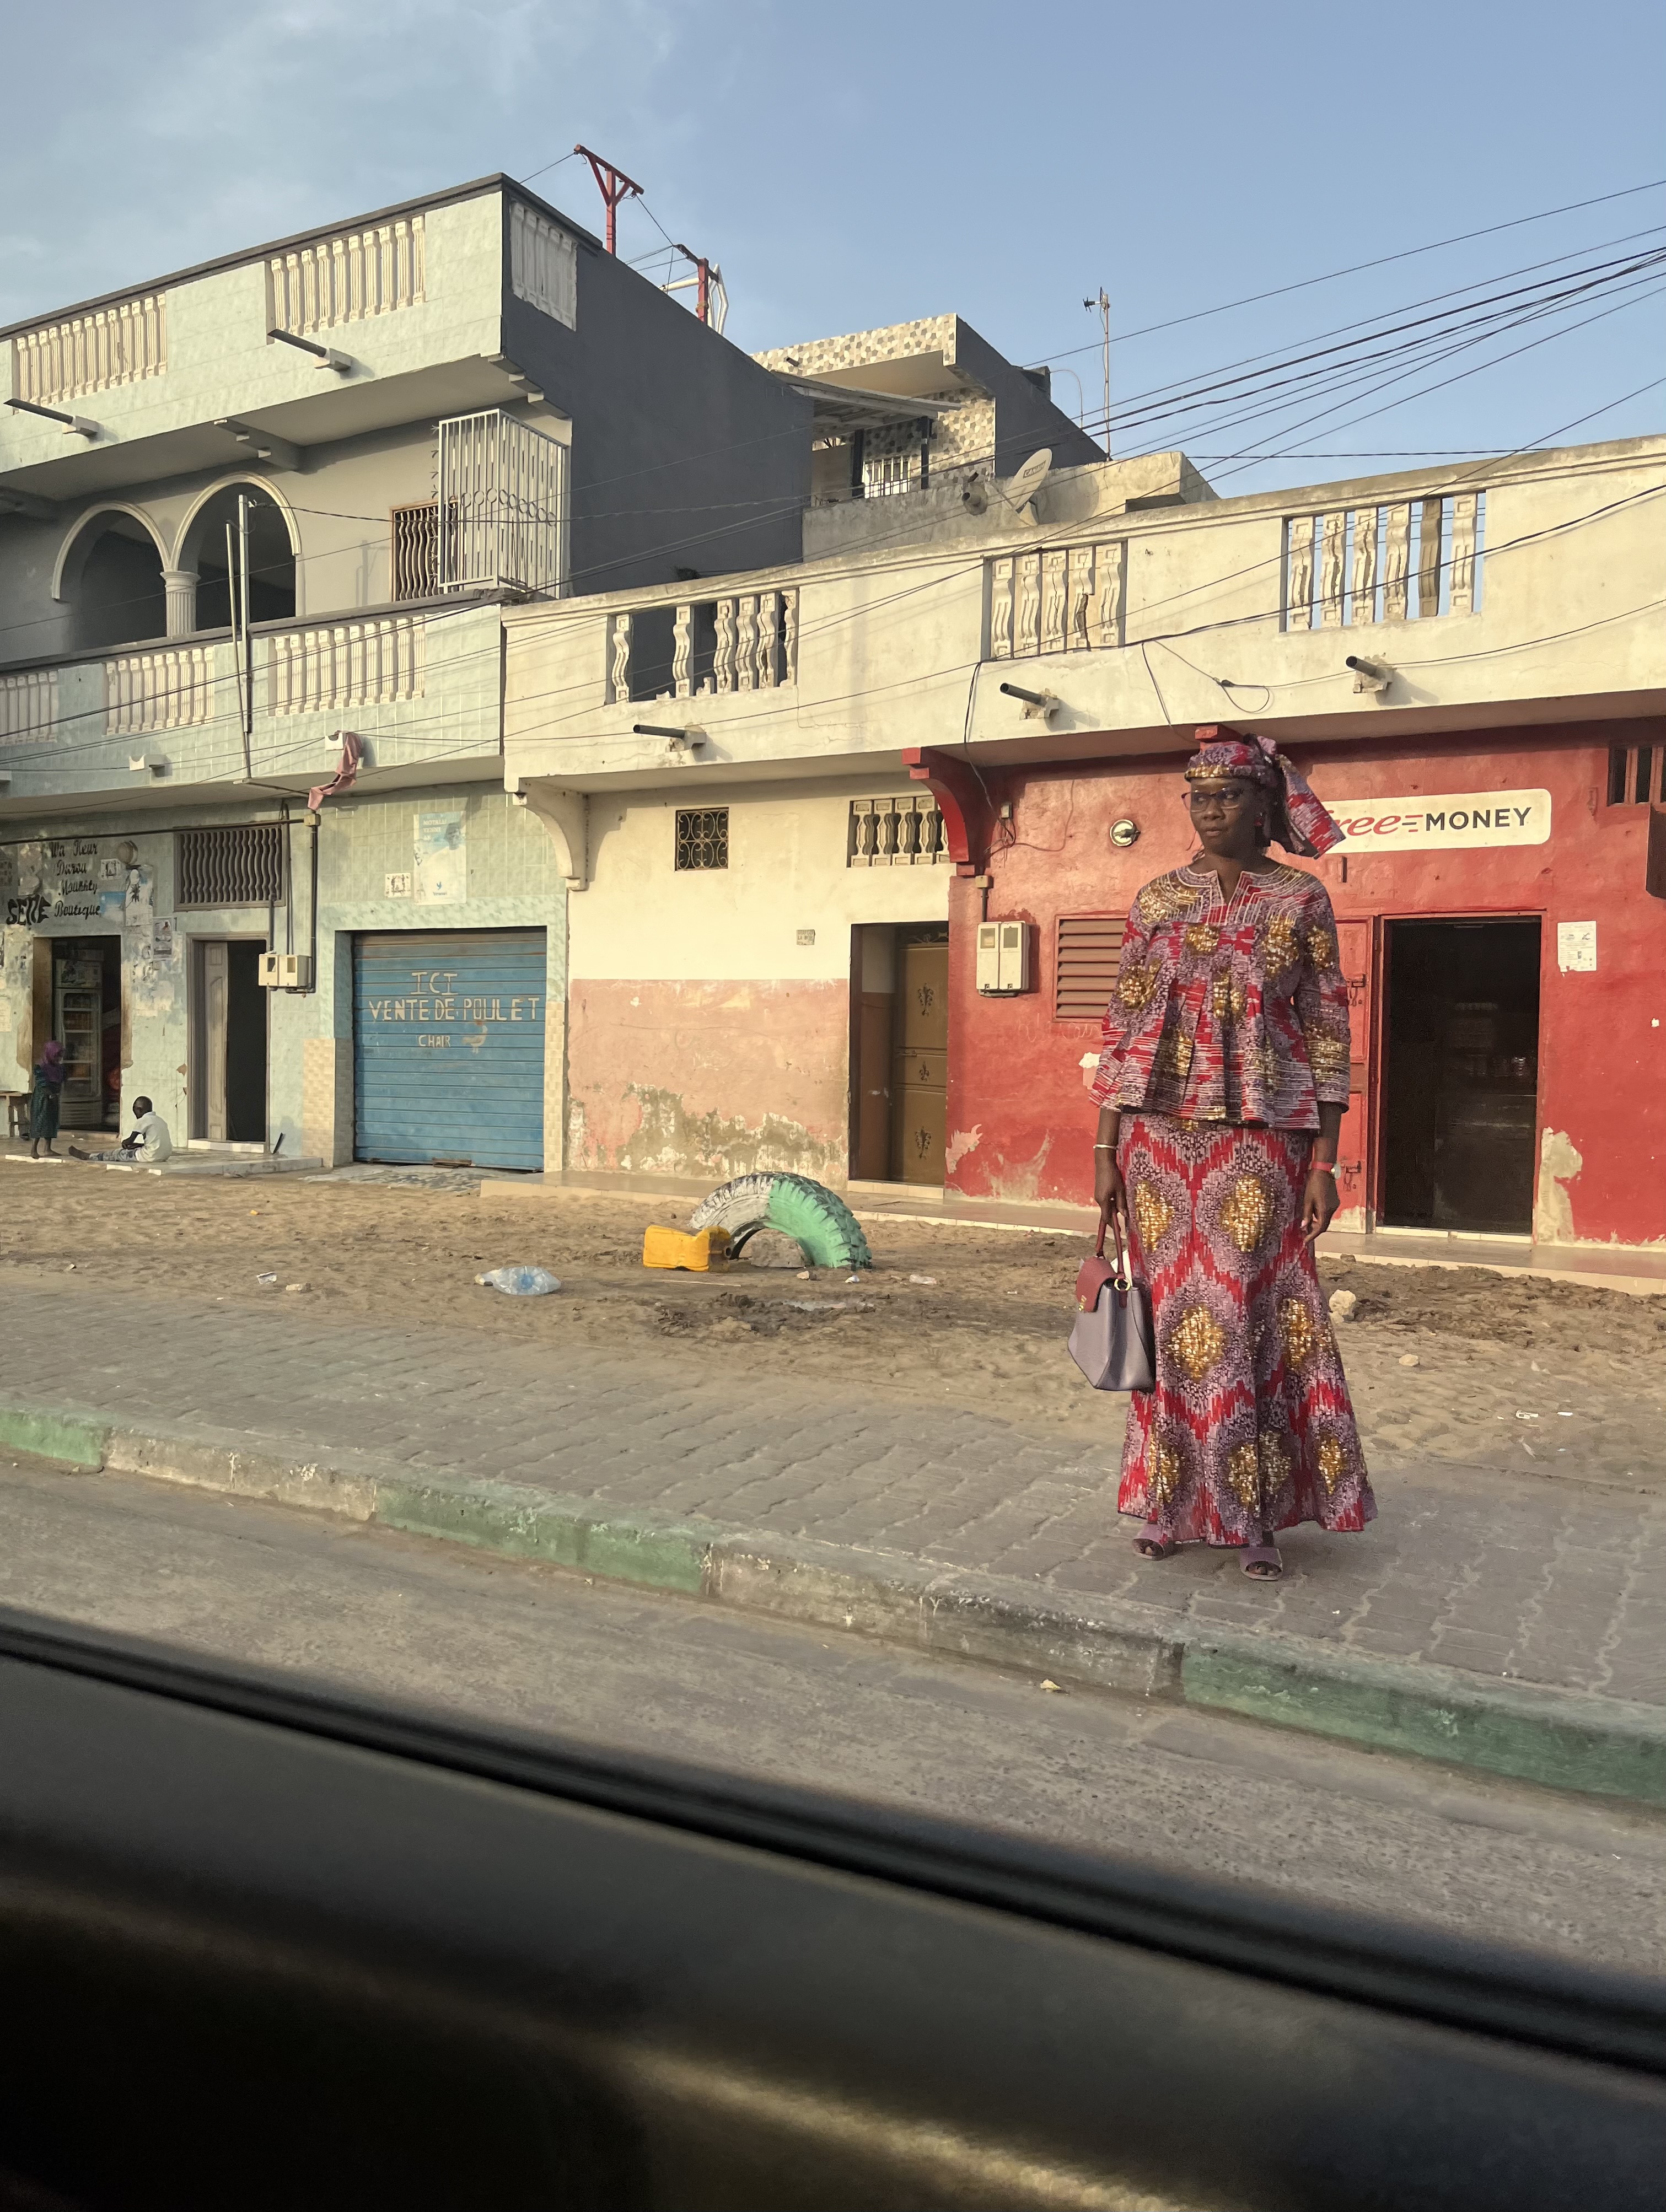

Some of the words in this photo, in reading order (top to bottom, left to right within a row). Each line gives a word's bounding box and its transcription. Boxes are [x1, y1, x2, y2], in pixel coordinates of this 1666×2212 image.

[1327, 809, 1401, 836] ree
[1426, 807, 1531, 831] MONEY
[54, 900, 101, 920] Boutique
[410, 971, 459, 995] ICI
[369, 999, 429, 1021] VENTE
[434, 998, 455, 1020] DE
[464, 997, 540, 1021] POULET
[418, 1034, 452, 1048] CHAIR
